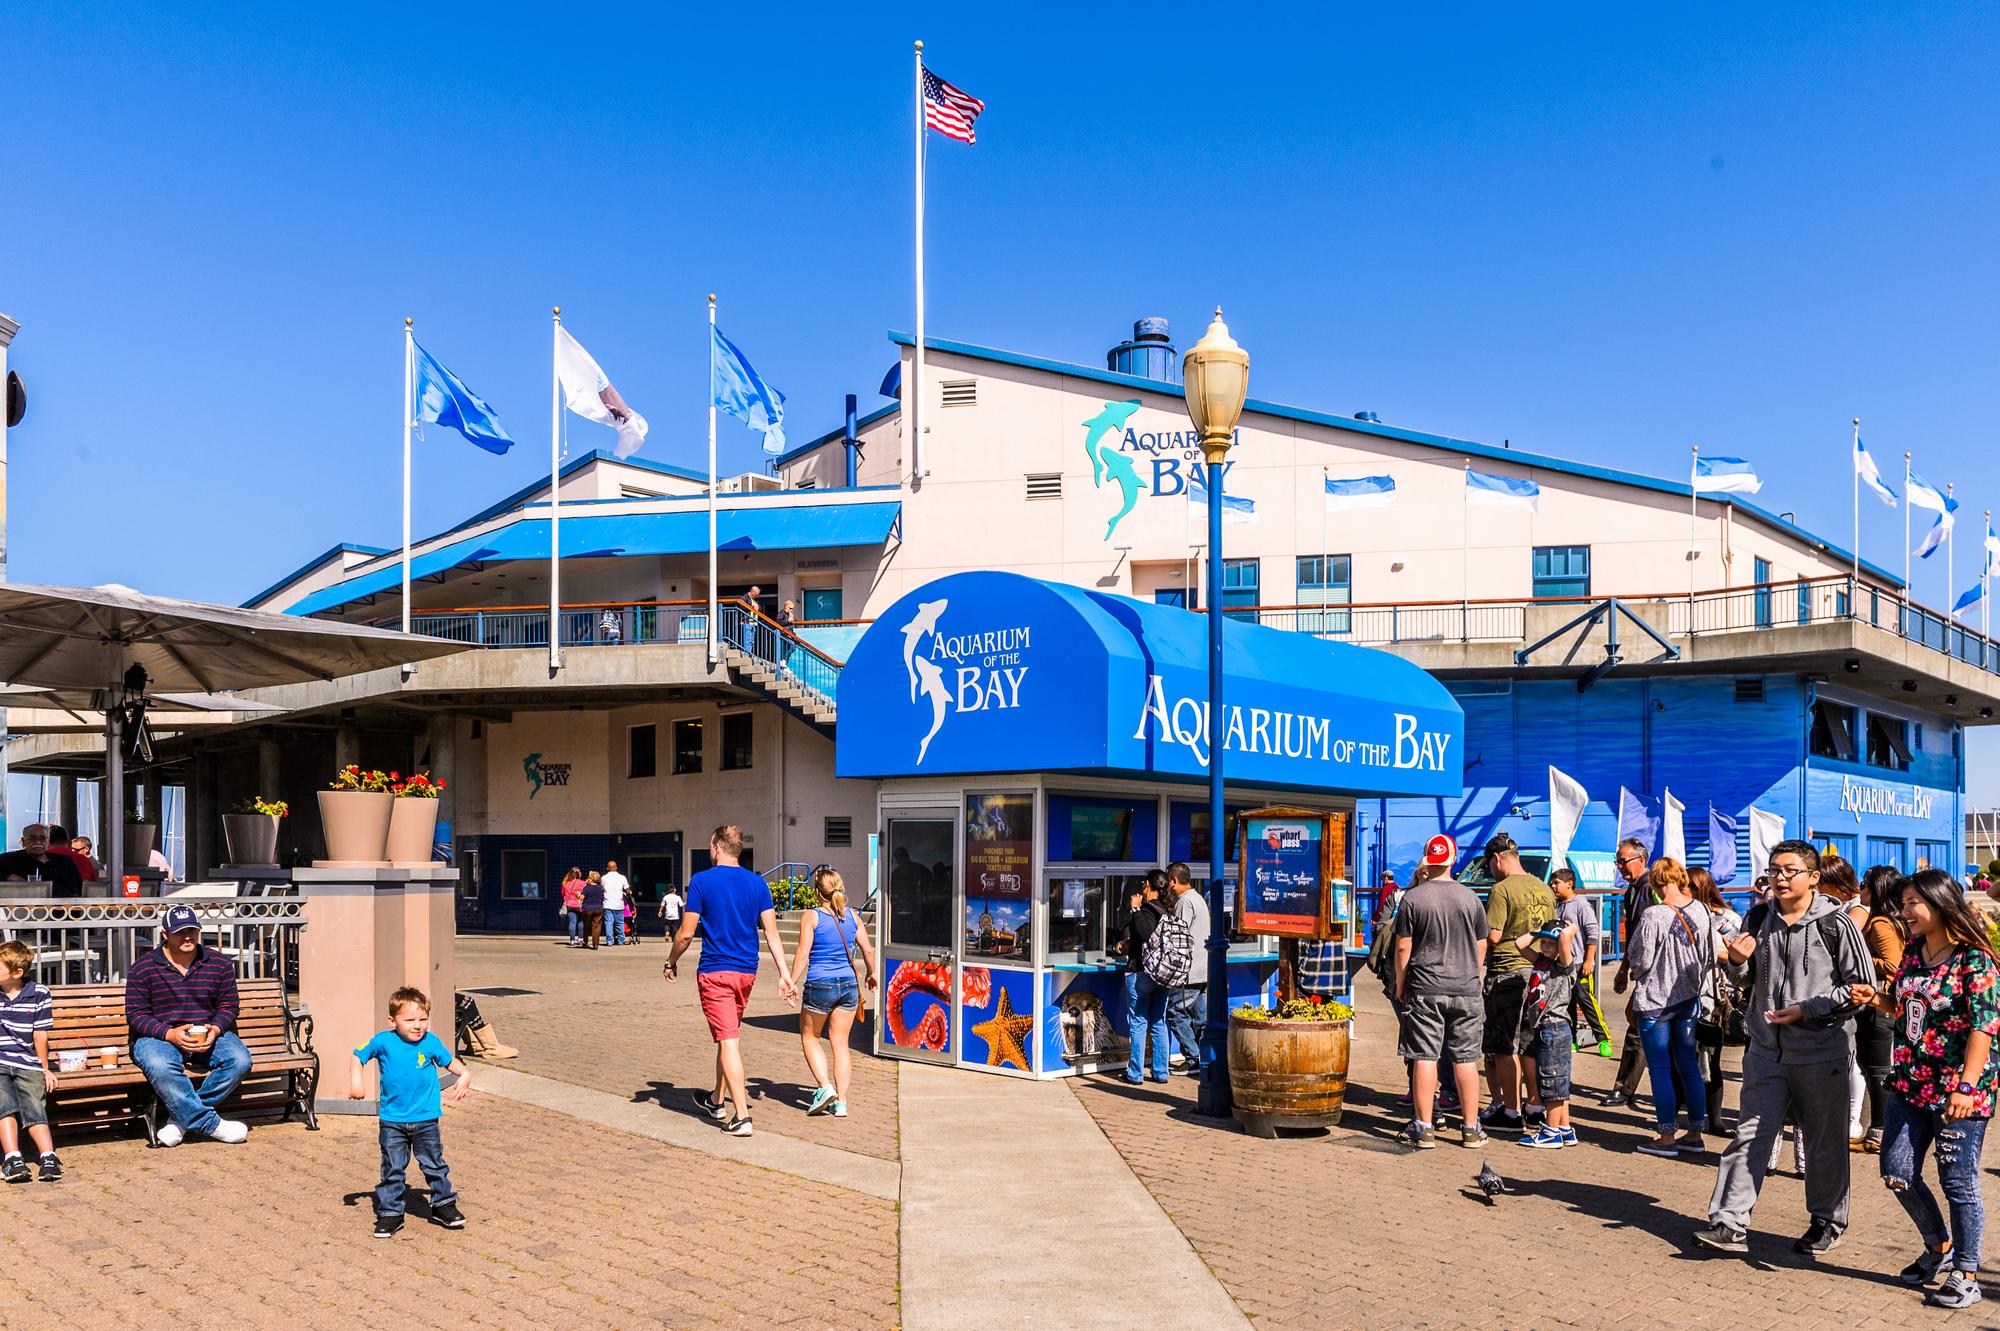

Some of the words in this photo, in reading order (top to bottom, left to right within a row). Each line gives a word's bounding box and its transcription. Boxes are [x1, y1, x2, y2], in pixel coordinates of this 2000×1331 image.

[1119, 428, 1239, 456] AQUAR
[1184, 450, 1200, 460] OF
[930, 627, 1031, 665] AQUARIUM
[983, 655, 997, 668] OF
[999, 652, 1021, 666] THE
[955, 666, 1029, 713] BAY
[1133, 674, 1330, 767] AQUARIUM
[1333, 739, 1356, 763] OF
[1358, 742, 1390, 767] THE
[1392, 713, 1451, 771] BAY
[535, 763, 571, 772] AQUARIUM
[544, 773, 570, 785] BAY
[1839, 774, 1895, 823] AQUARIUM
[1913, 784, 1932, 819] BAY
[1280, 831, 1301, 840] wharf
[1000, 874, 1012, 882] BIG
